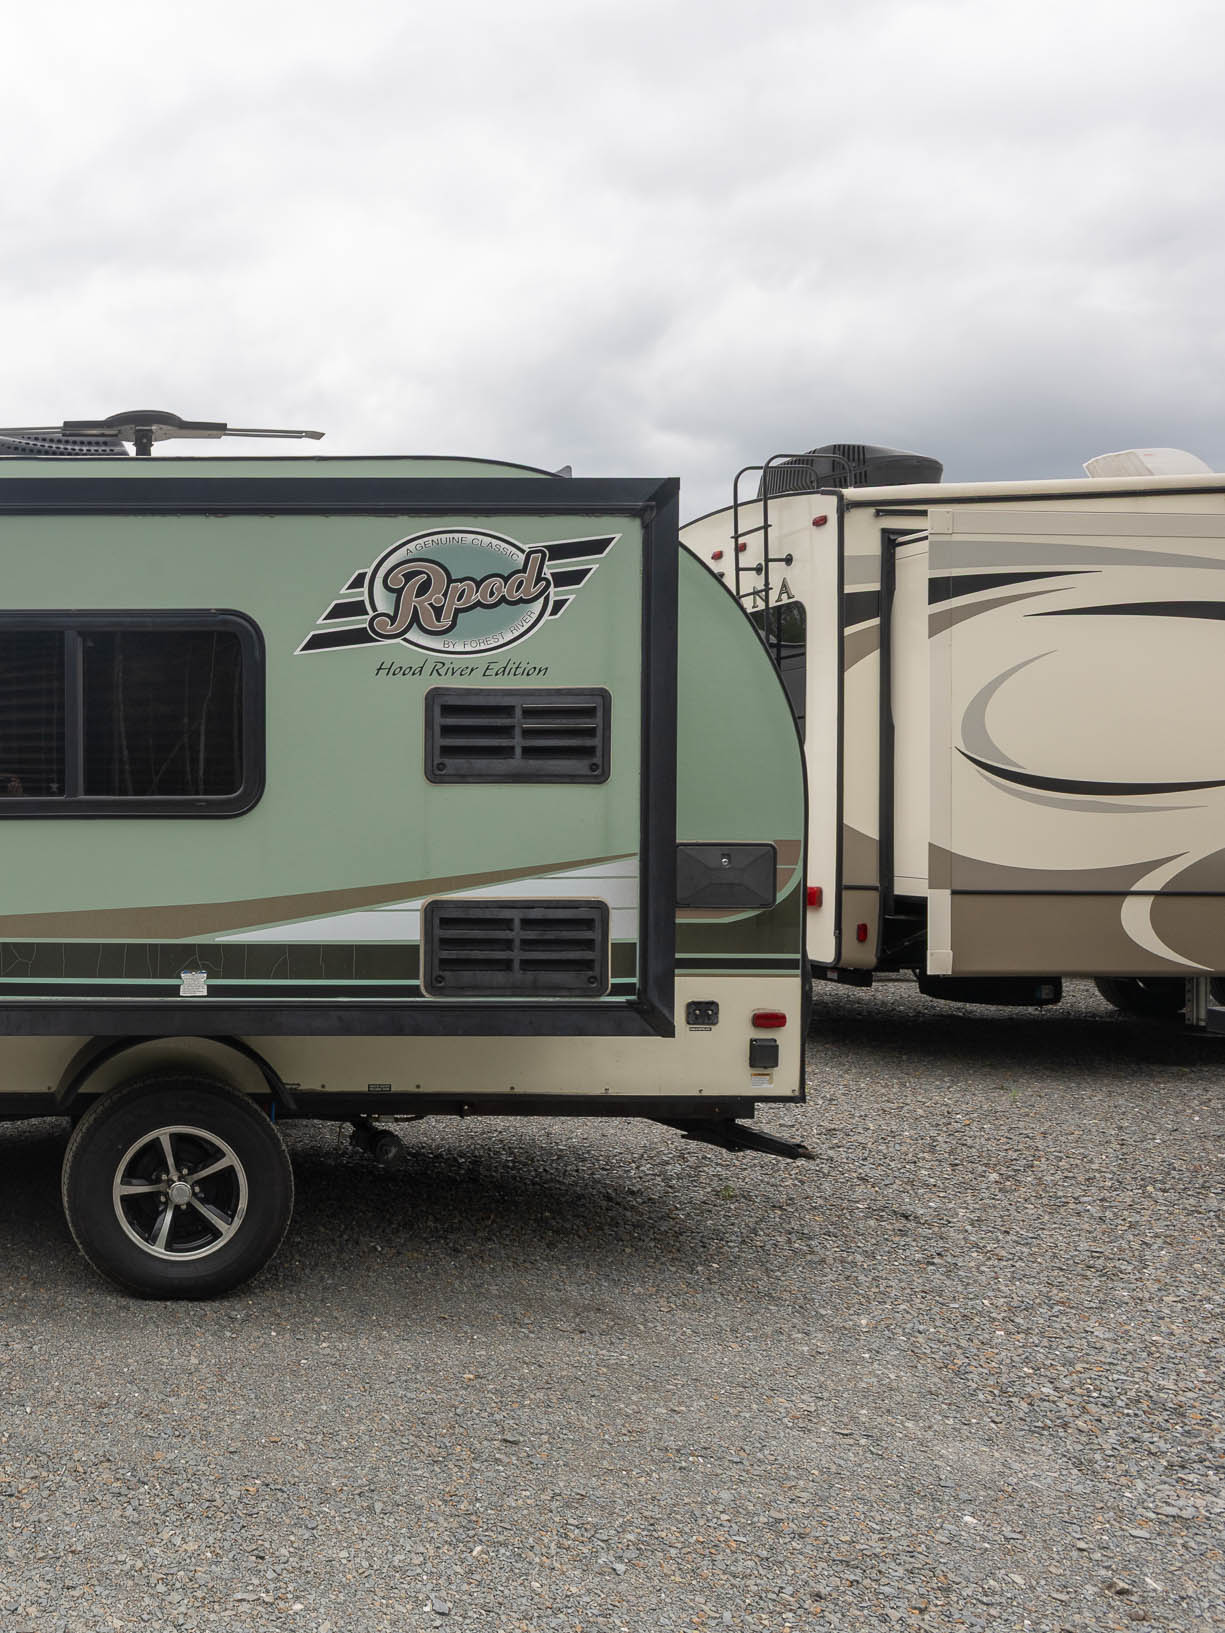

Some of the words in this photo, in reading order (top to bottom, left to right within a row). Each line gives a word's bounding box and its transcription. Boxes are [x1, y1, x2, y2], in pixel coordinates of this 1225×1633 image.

[405, 548, 413, 556] A
[415, 536, 468, 551] GENUINE
[471, 537, 520, 561] CLASSIC
[443, 639, 457, 649] BY
[463, 631, 507, 649] FOREST
[509, 609, 536, 635] RIVER
[375, 658, 428, 677] Hood
[428, 660, 479, 677] River
[482, 658, 549, 677] Edition
